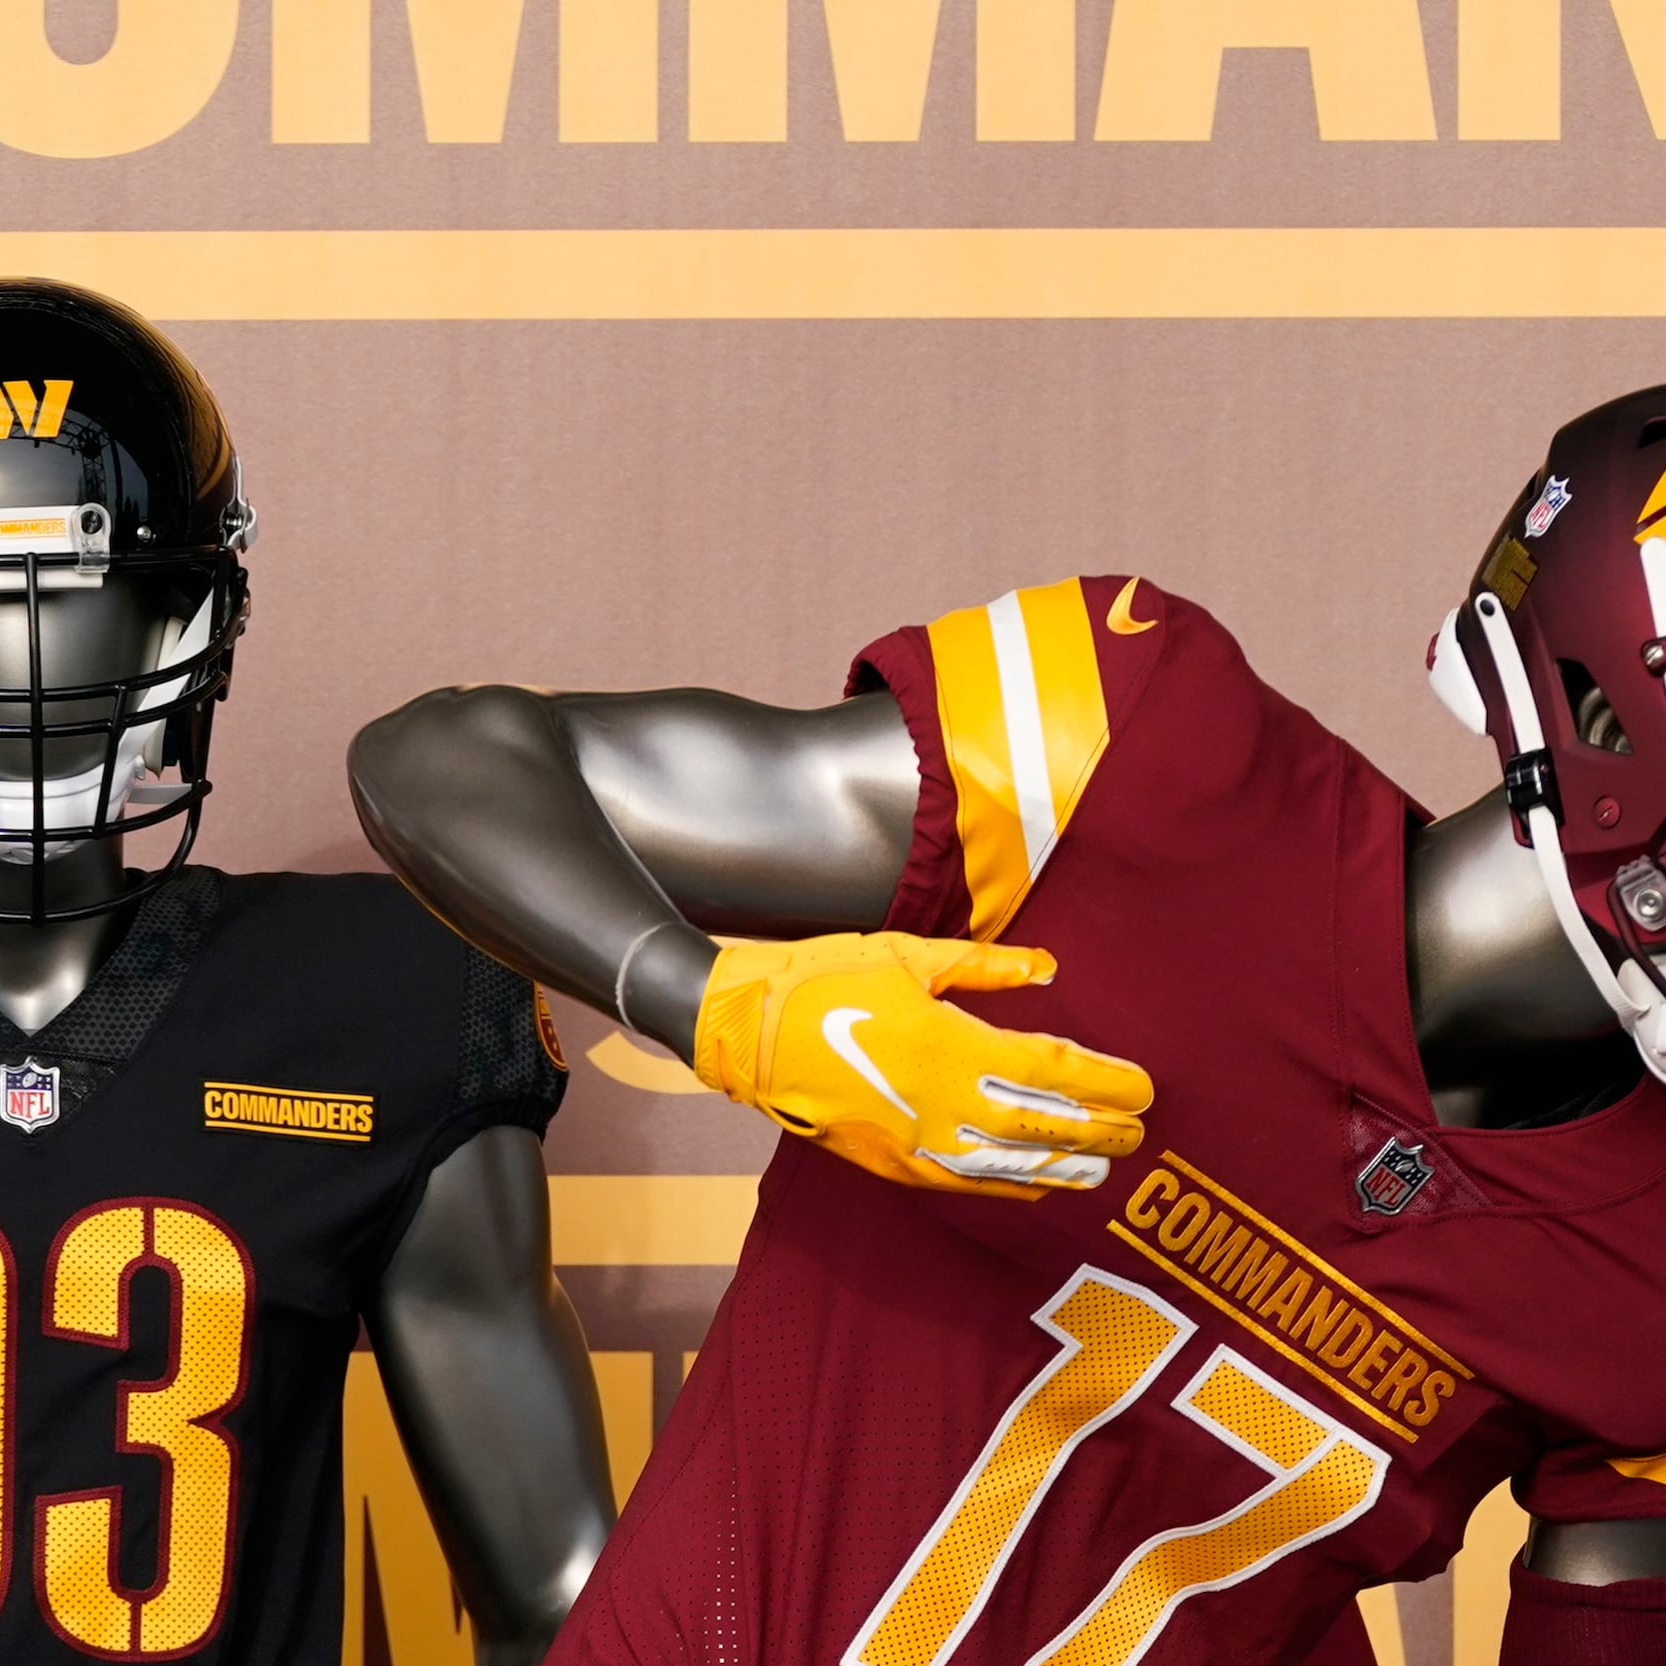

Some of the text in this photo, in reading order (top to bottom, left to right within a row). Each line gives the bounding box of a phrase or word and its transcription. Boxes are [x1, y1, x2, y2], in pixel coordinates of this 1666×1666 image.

[1532, 501, 1551, 529] NFL
[9, 1091, 50, 1118] NFL
[204, 1089, 374, 1133] COMMANDERS
[1365, 1166, 1406, 1206] NFL
[1123, 1166, 1458, 1429] COMMANDERS
